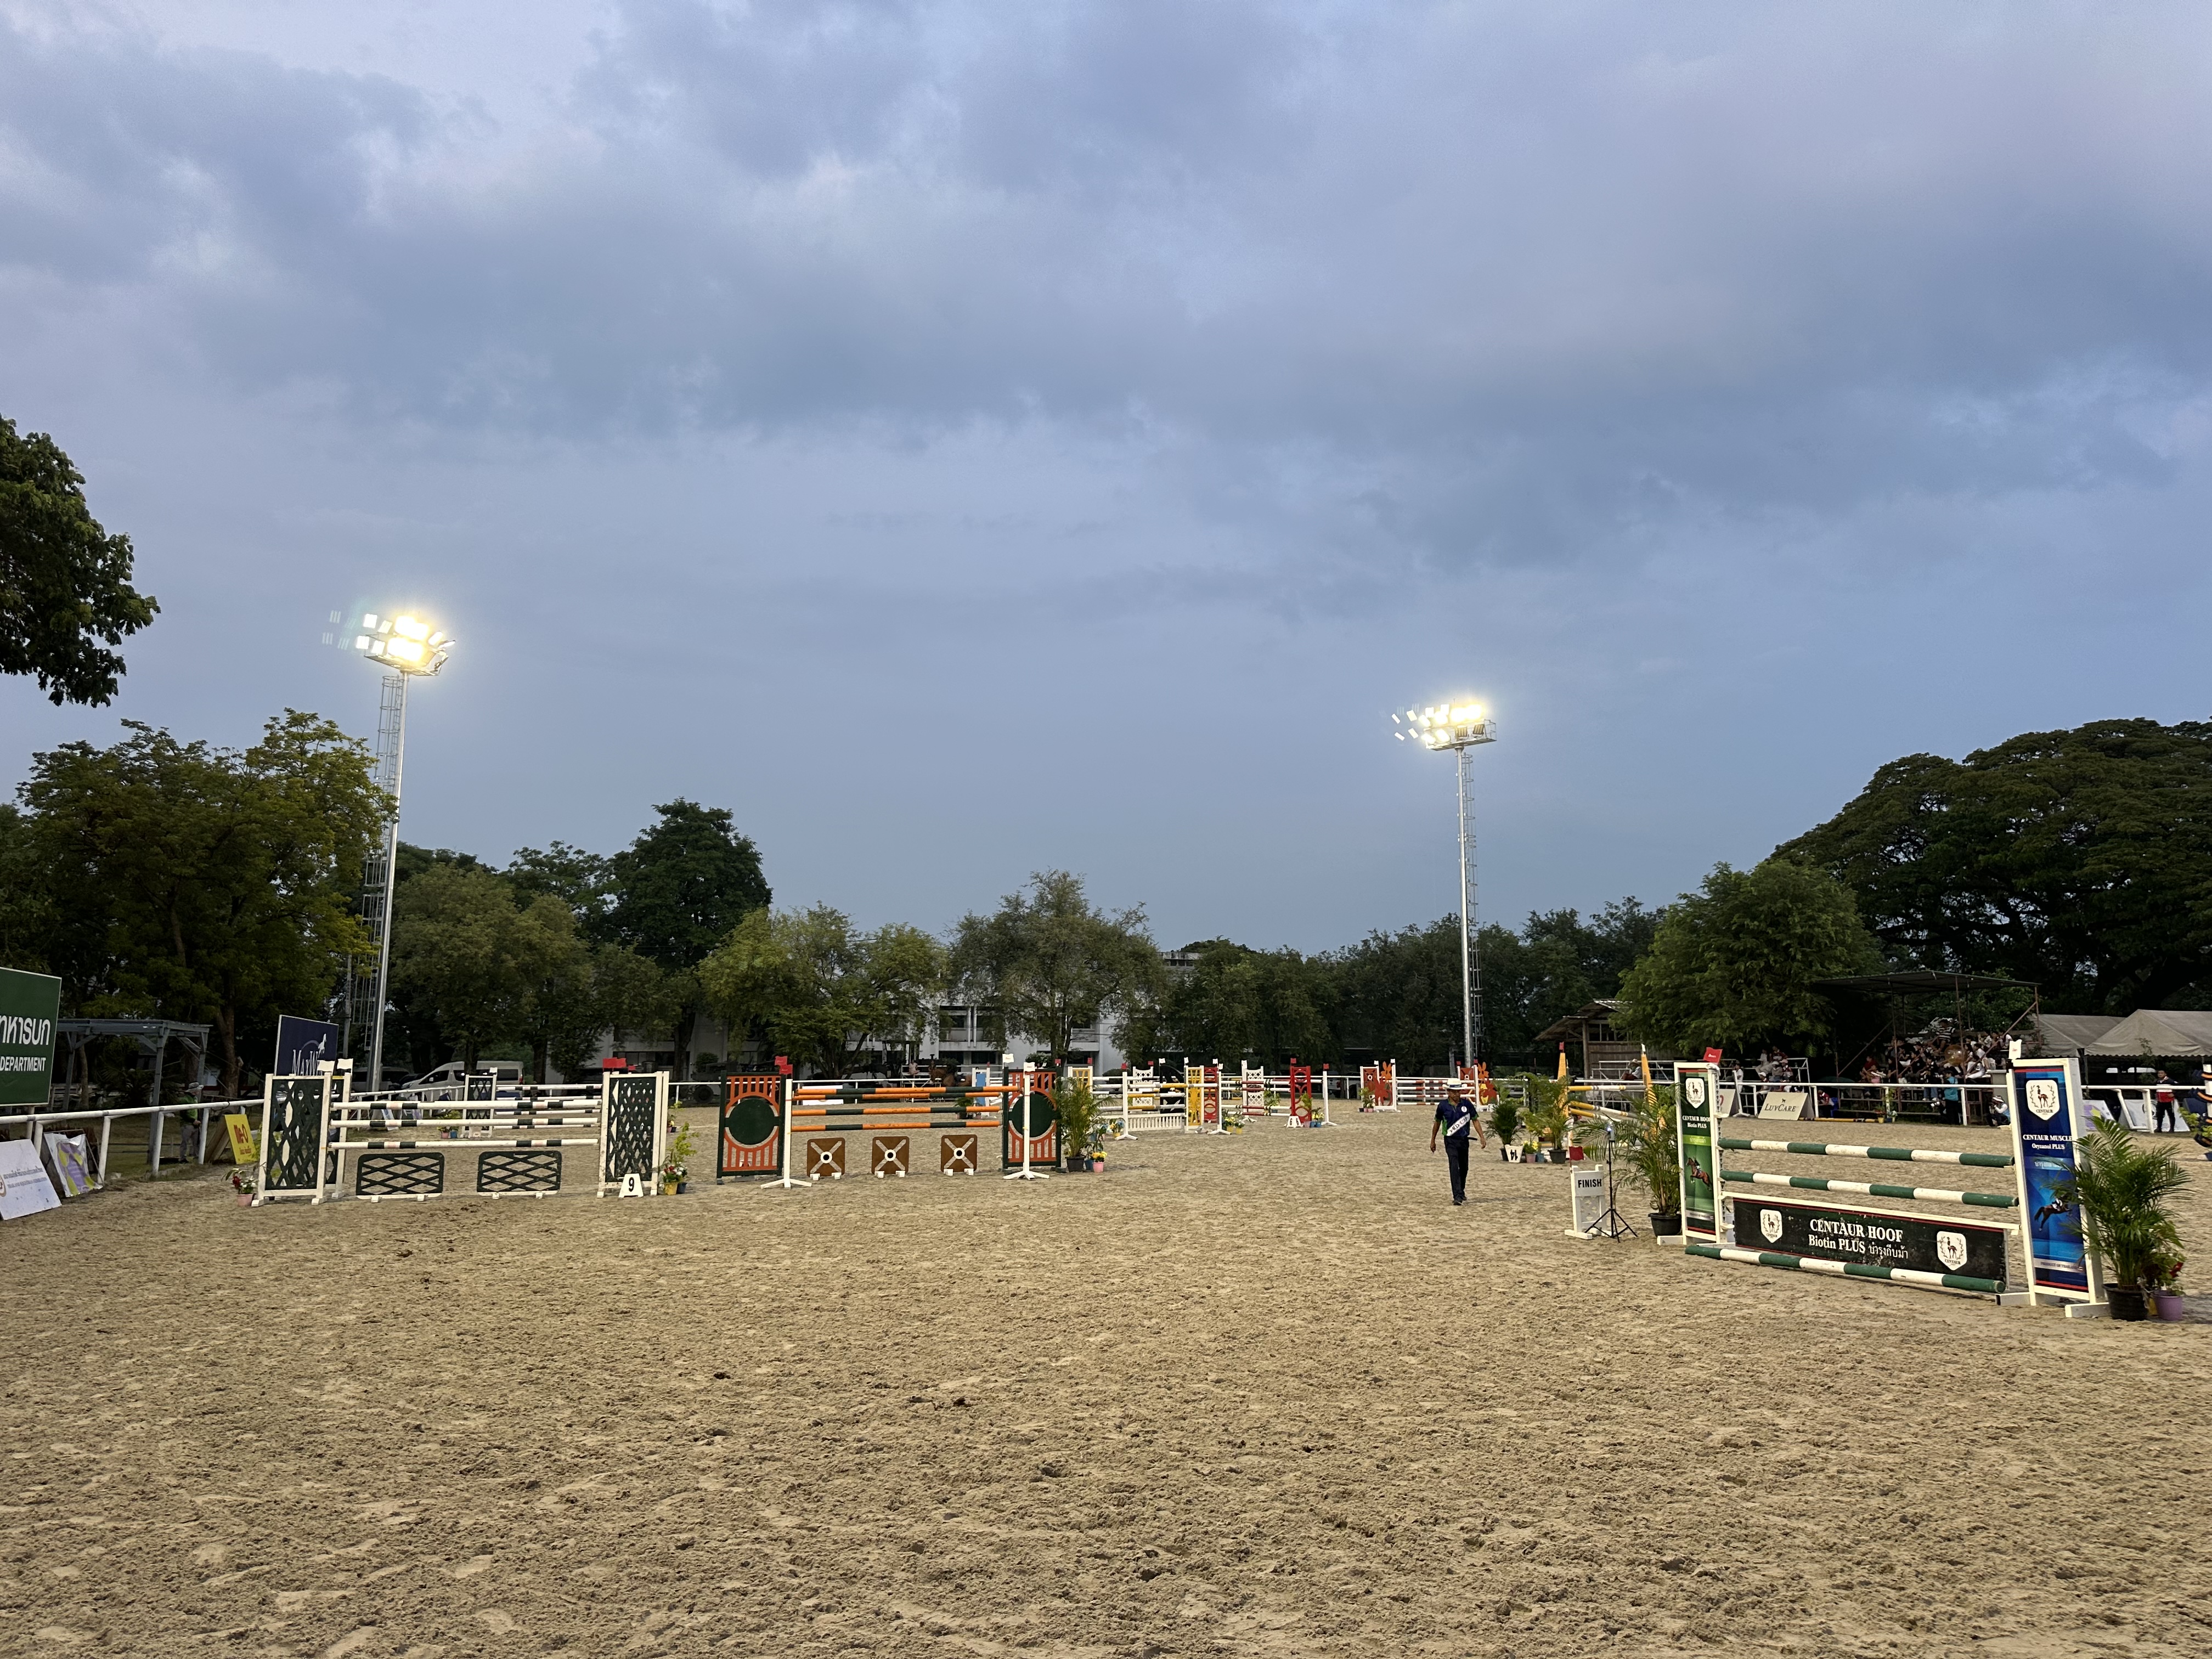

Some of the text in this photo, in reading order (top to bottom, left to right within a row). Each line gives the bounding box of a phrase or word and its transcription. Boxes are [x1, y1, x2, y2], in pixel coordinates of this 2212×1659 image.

[0, 1056, 46, 1071] DEPARTMENT
[628, 1177, 635, 1192] 9
[1578, 1178, 1602, 1188] FINISH
[1810, 1218, 1903, 1243] CENTAUR HOOF
[1808, 1234, 1837, 1249] Biotin
[1838, 1238, 1866, 1254] PLUS
